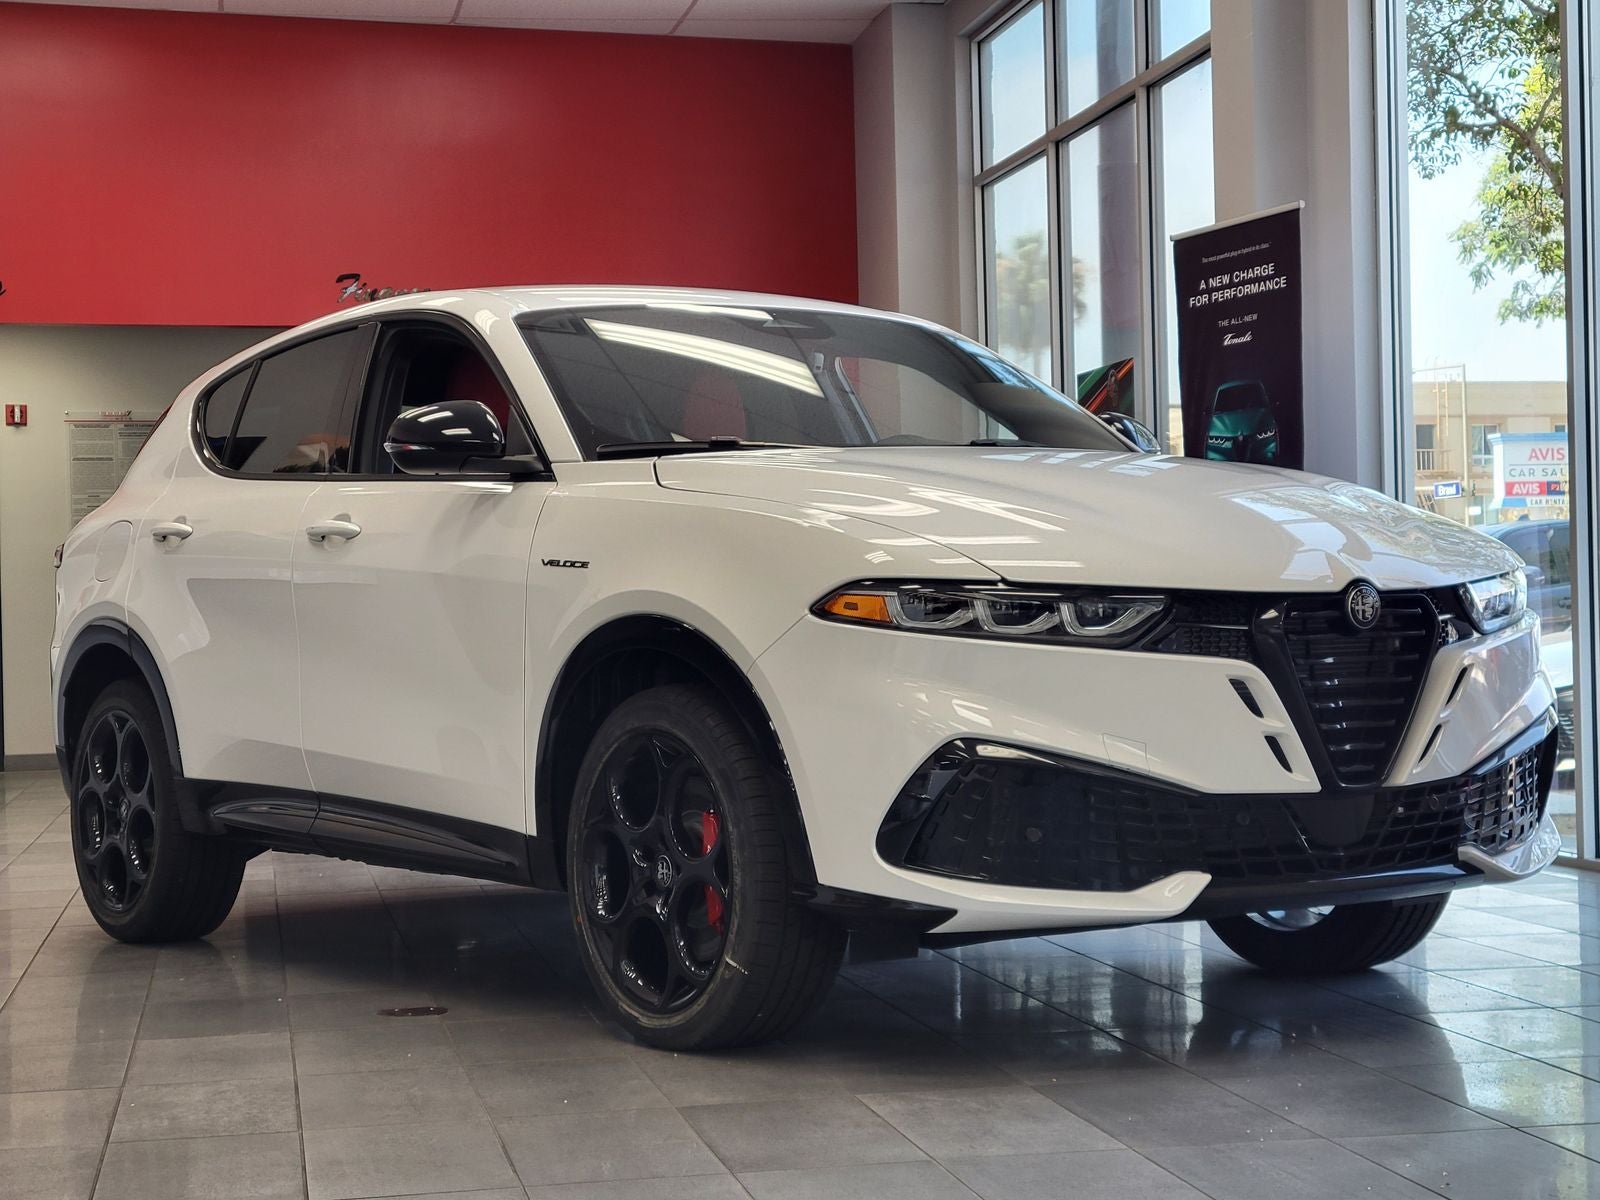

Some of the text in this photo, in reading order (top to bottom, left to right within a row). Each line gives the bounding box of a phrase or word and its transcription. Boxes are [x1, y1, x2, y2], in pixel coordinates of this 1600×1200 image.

[1199, 263, 1275, 290] A NEW CHARGE
[1189, 276, 1287, 308] FOR PERFORMANCE
[1218, 313, 1258, 328] THE ALL-NEW
[1223, 330, 1253, 346] Tonale
[1528, 447, 1565, 461] AVIS
[1509, 467, 1536, 478] CAR
[1512, 482, 1541, 495] AVIS
[541, 558, 590, 569] VELOCE
